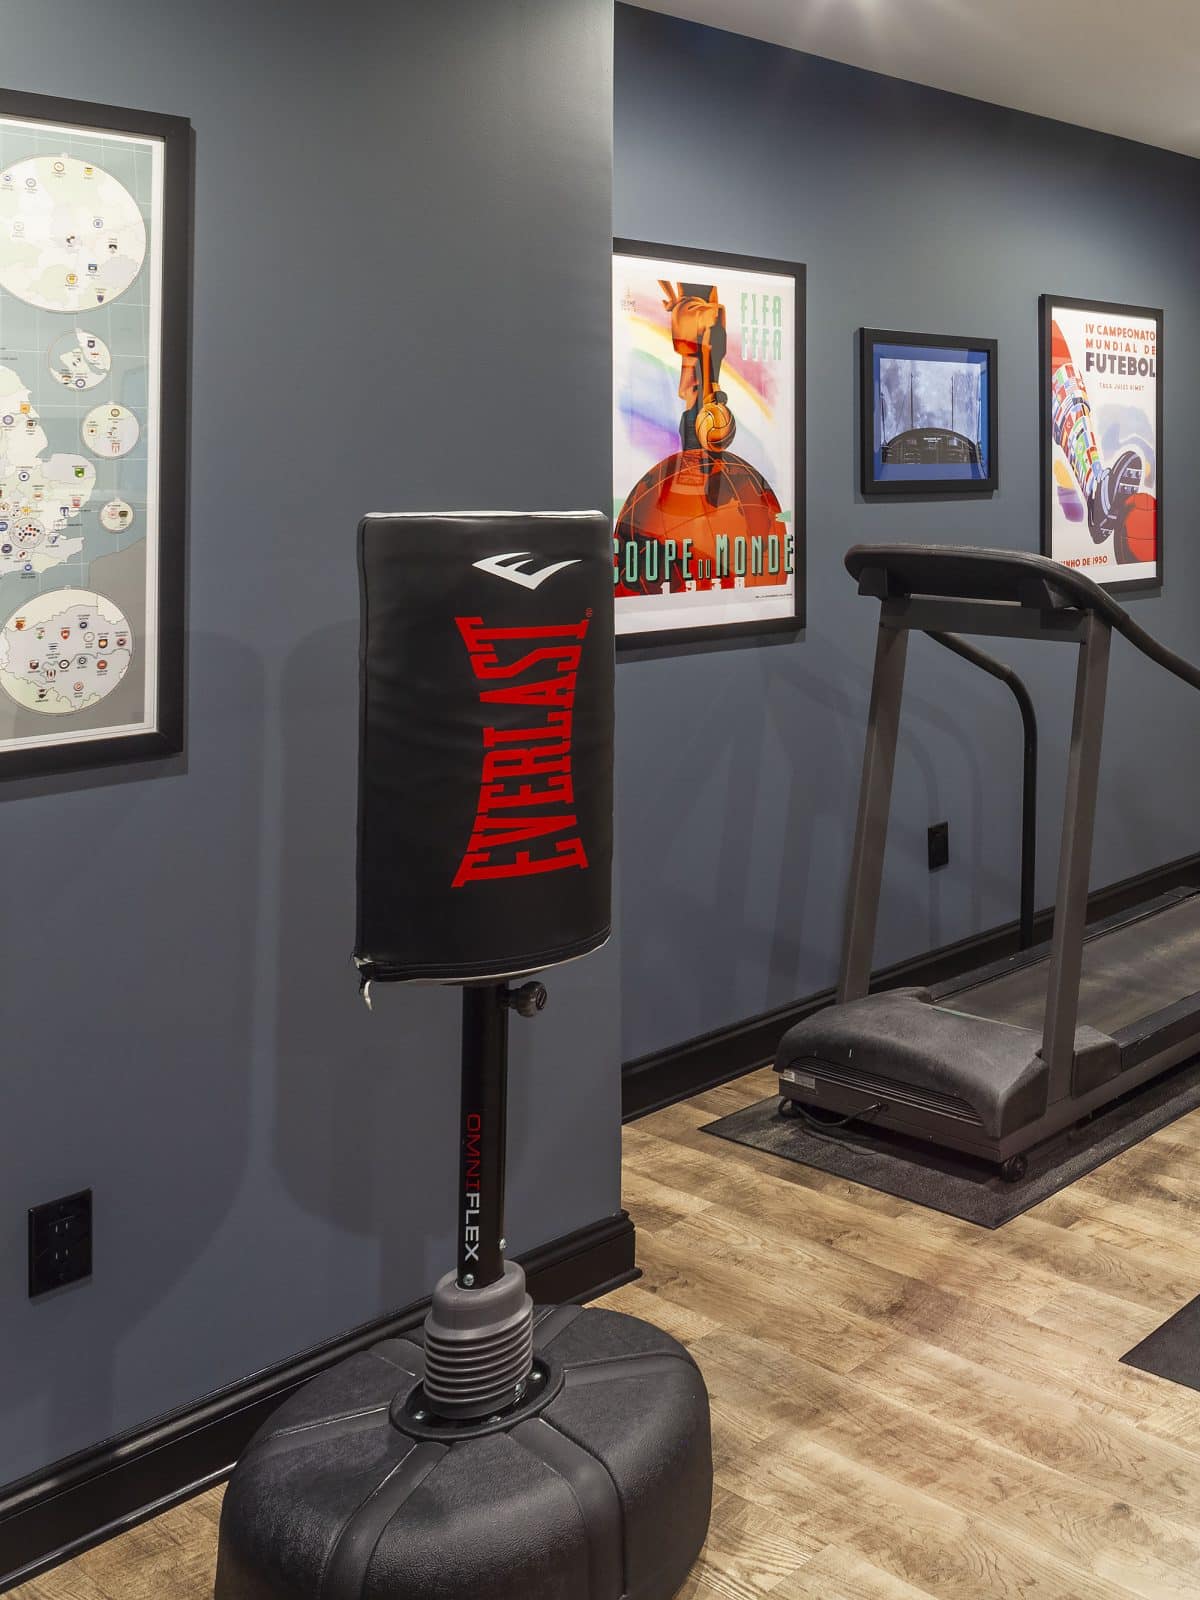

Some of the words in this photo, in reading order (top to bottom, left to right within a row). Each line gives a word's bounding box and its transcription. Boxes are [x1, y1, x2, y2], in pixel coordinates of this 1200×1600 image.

[1085, 323, 1095, 334] IV
[1097, 325, 1156, 341] CAMPEONATO
[1085, 337, 1138, 353] MUNDIAL
[1144, 344, 1156, 355] DE
[1085, 351, 1156, 378] FUTEBOL
[715, 533, 793, 577] MONDE
[1082, 557, 1091, 566] DE
[1092, 555, 1108, 565] 1950
[451, 617, 590, 888] EVERLAST
[464, 1112, 481, 1262] OMNIFLEX
